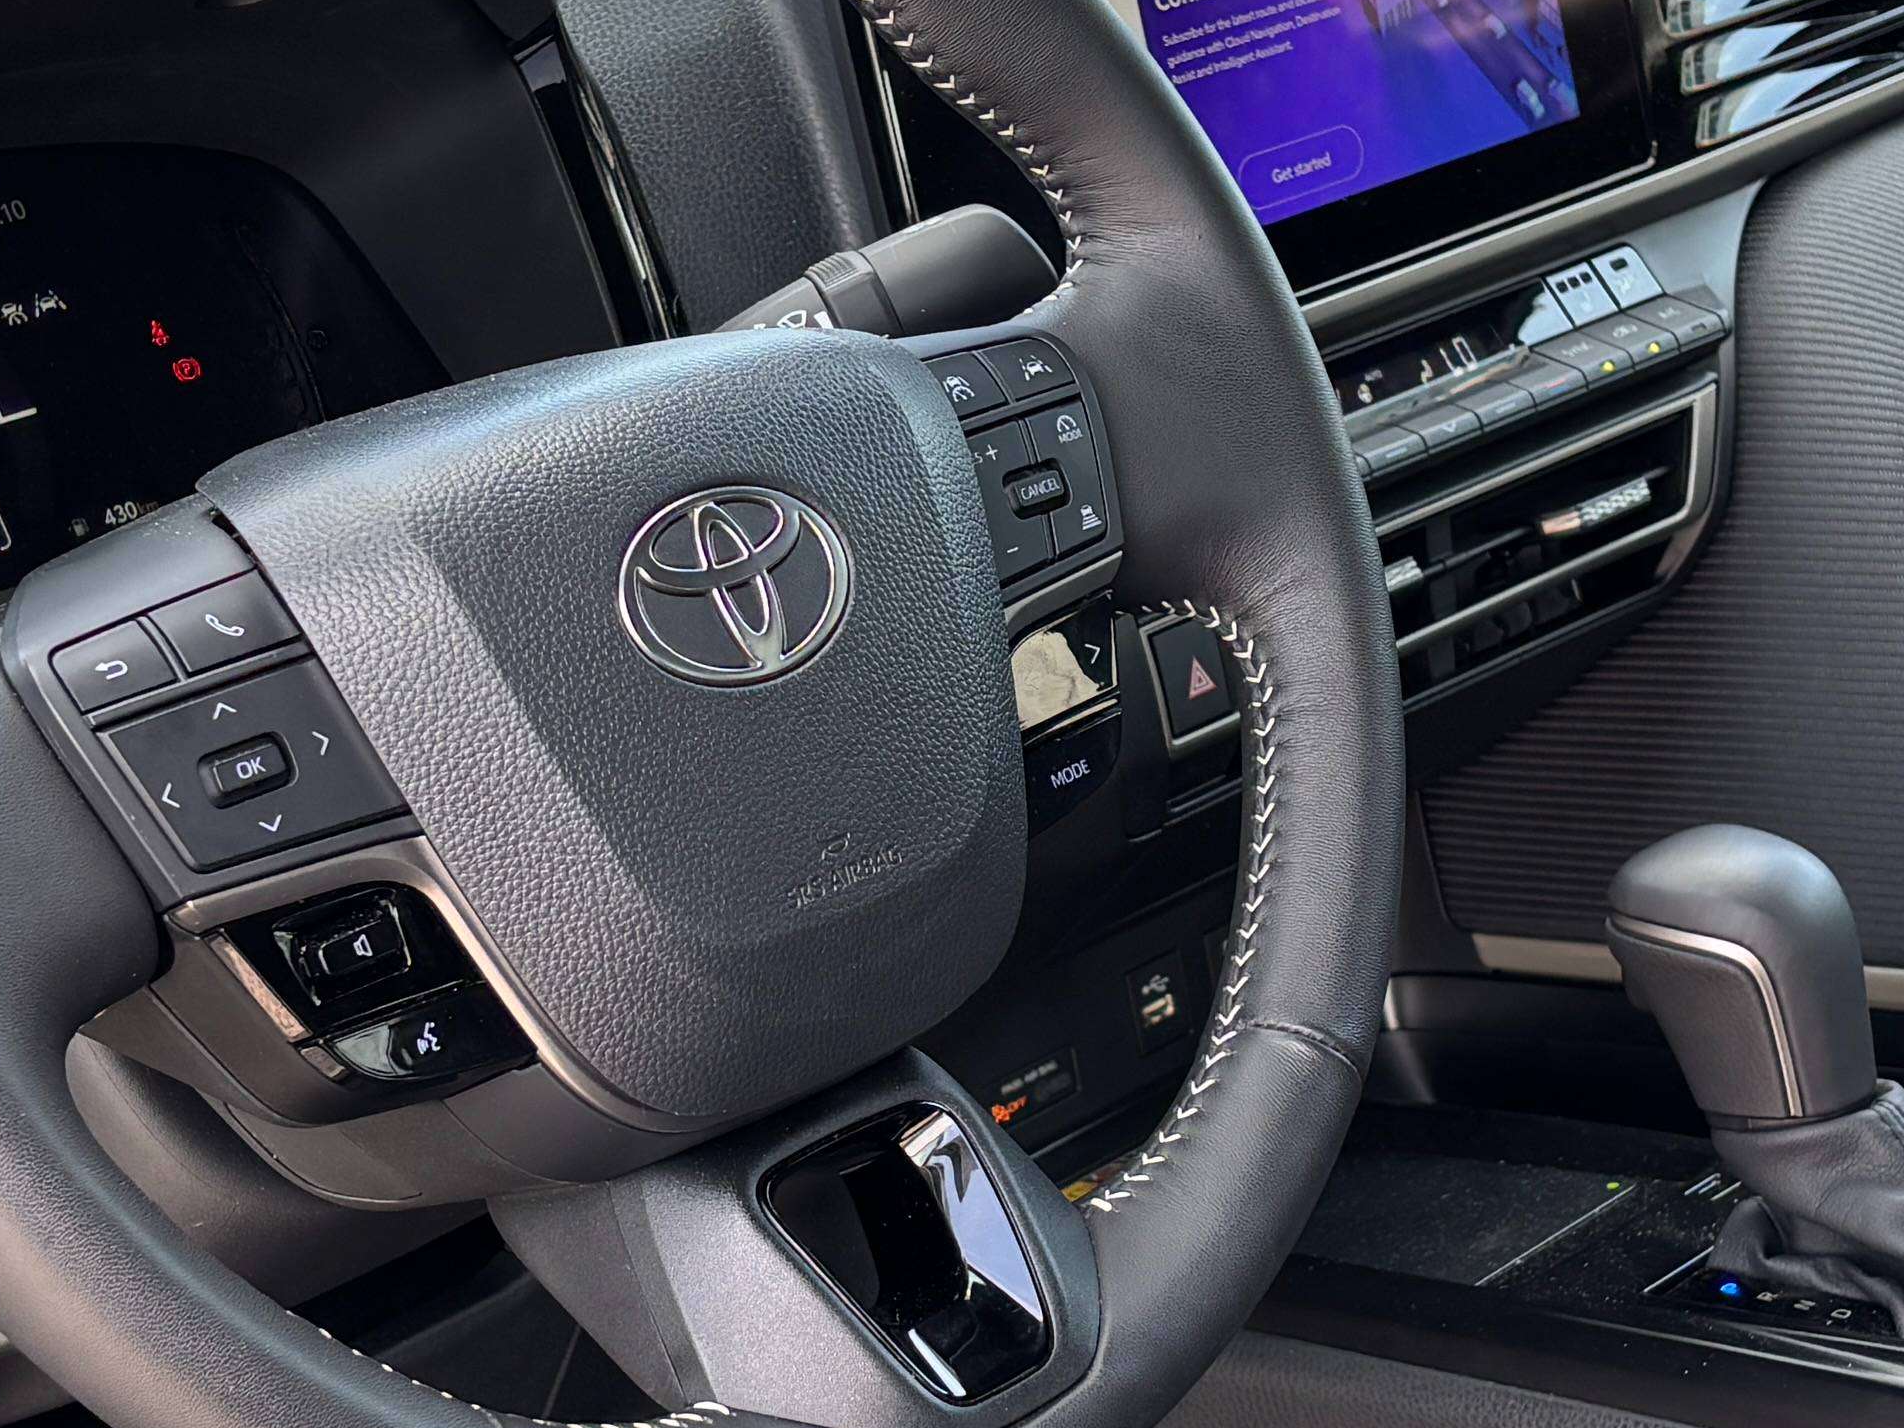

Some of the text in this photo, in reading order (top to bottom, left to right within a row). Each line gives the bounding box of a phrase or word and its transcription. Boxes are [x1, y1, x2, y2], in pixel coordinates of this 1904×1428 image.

[1162, 24, 1206, 47] Subscribe
[1217, 16, 1232, 31] the
[1232, 8, 1255, 27] latest
[1166, 47, 1206, 70] guidance
[1206, 39, 1225, 56] with
[1224, 31, 1252, 50] Cloud
[1295, 5, 1343, 29] Destination
[1271, 151, 1333, 184] Get started
[1057, 430, 1084, 444] MODE
[1020, 476, 1061, 501] CANCEL
[235, 755, 268, 779] OK
[1049, 757, 1092, 791] MODE
[831, 846, 904, 893] AIRBAG
